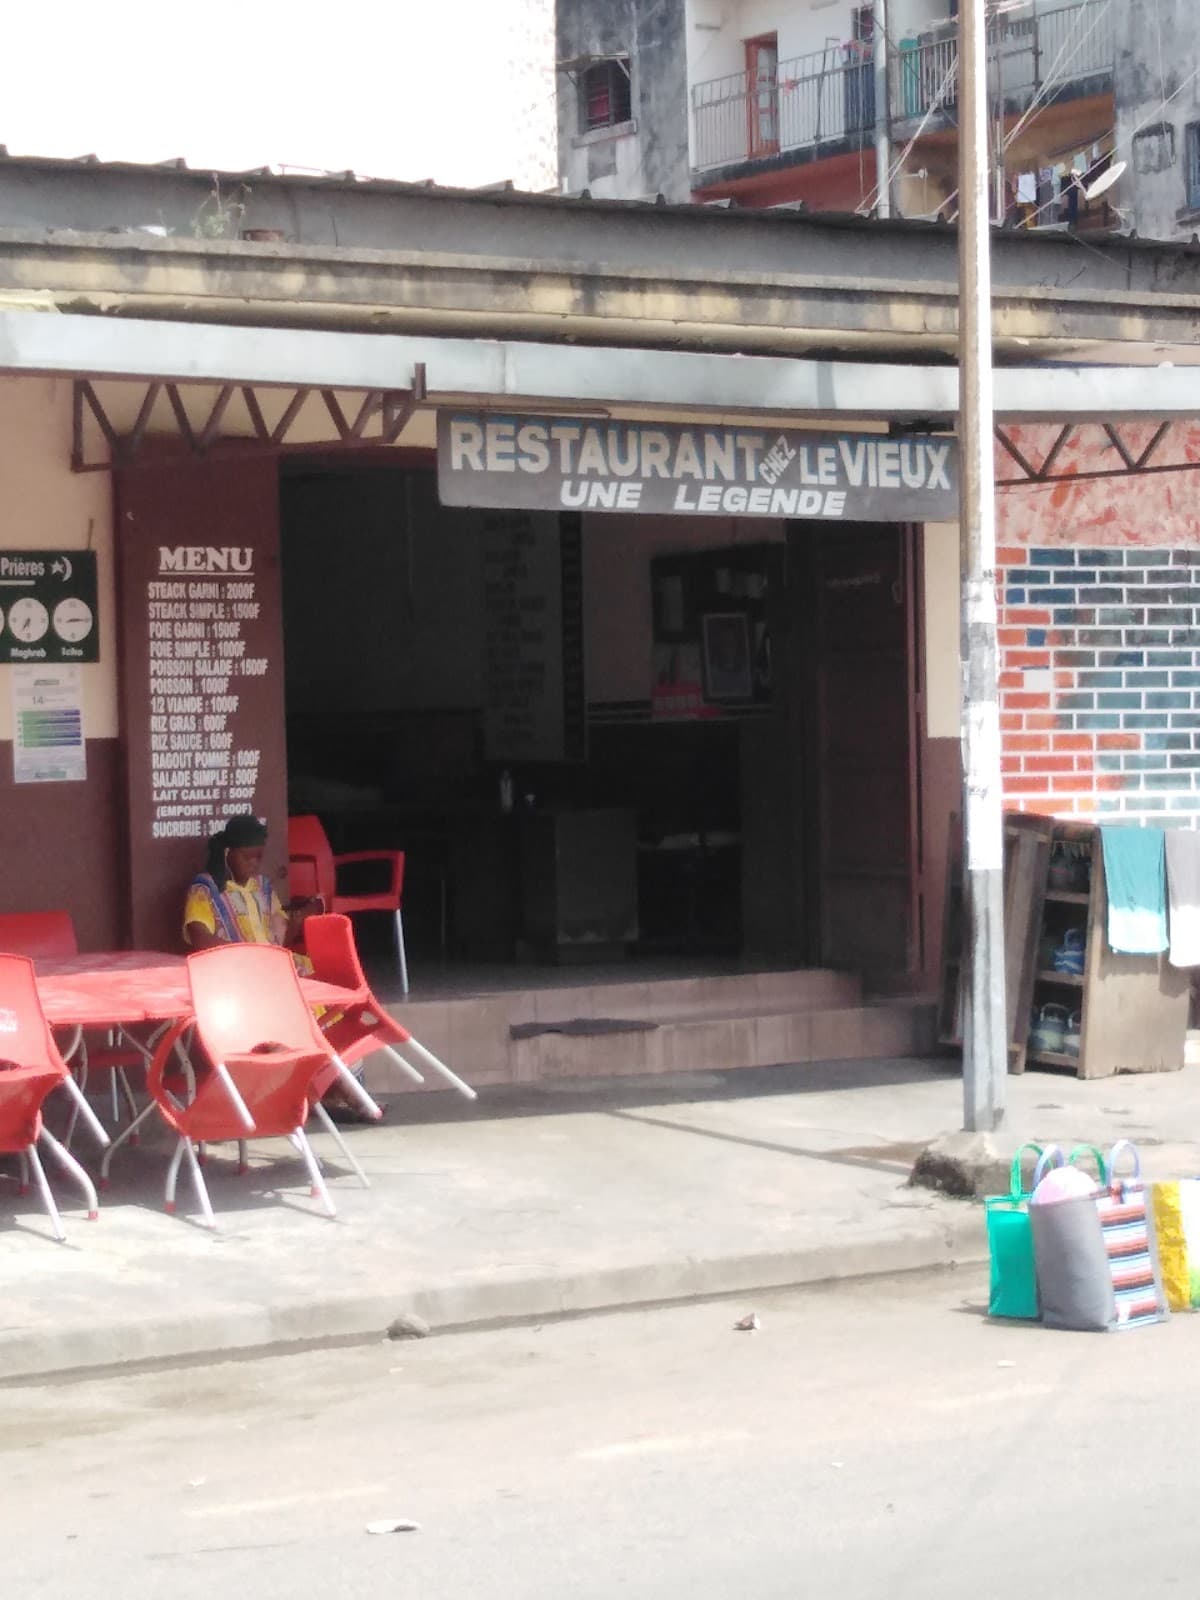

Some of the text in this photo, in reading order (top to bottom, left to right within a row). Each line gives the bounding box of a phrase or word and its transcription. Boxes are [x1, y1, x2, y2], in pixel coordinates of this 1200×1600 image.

[450, 421, 951, 490] RESTAURANT CHEZ LE VIEUX
[560, 480, 846, 516] UNE LEGENDE
[159, 547, 254, 571] MENU
[148, 582, 185, 599] STEACK
[189, 582, 219, 599] GARNI
[227, 583, 255, 599] 2000F
[149, 602, 187, 618] STEACK
[190, 603, 224, 618] SIMPLE
[150, 622, 171, 638] FOIE
[174, 622, 204, 638] GARNI
[150, 641, 172, 657] FOIE
[175, 642, 210, 656] SIMPLE
[150, 660, 193, 676] POISSON
[195, 660, 232, 675] SALADE
[150, 678, 193, 694] POISSON
[167, 697, 203, 713] VIANDE
[151, 716, 167, 732] RIZ
[170, 716, 196, 732] GRAS
[151, 734, 167, 750] RIZ
[170, 734, 203, 750] SAUCE
[152, 752, 192, 769] RAGOUT
[152, 771, 191, 787] SALADE
[193, 770, 228, 786] SIMPLE
[153, 791, 178, 801] LAIT
[181, 790, 220, 800] CAILLE
[229, 788, 255, 798] 500F
[156, 805, 213, 819] (EMPORTE
[153, 821, 200, 837] SUCRERIE
